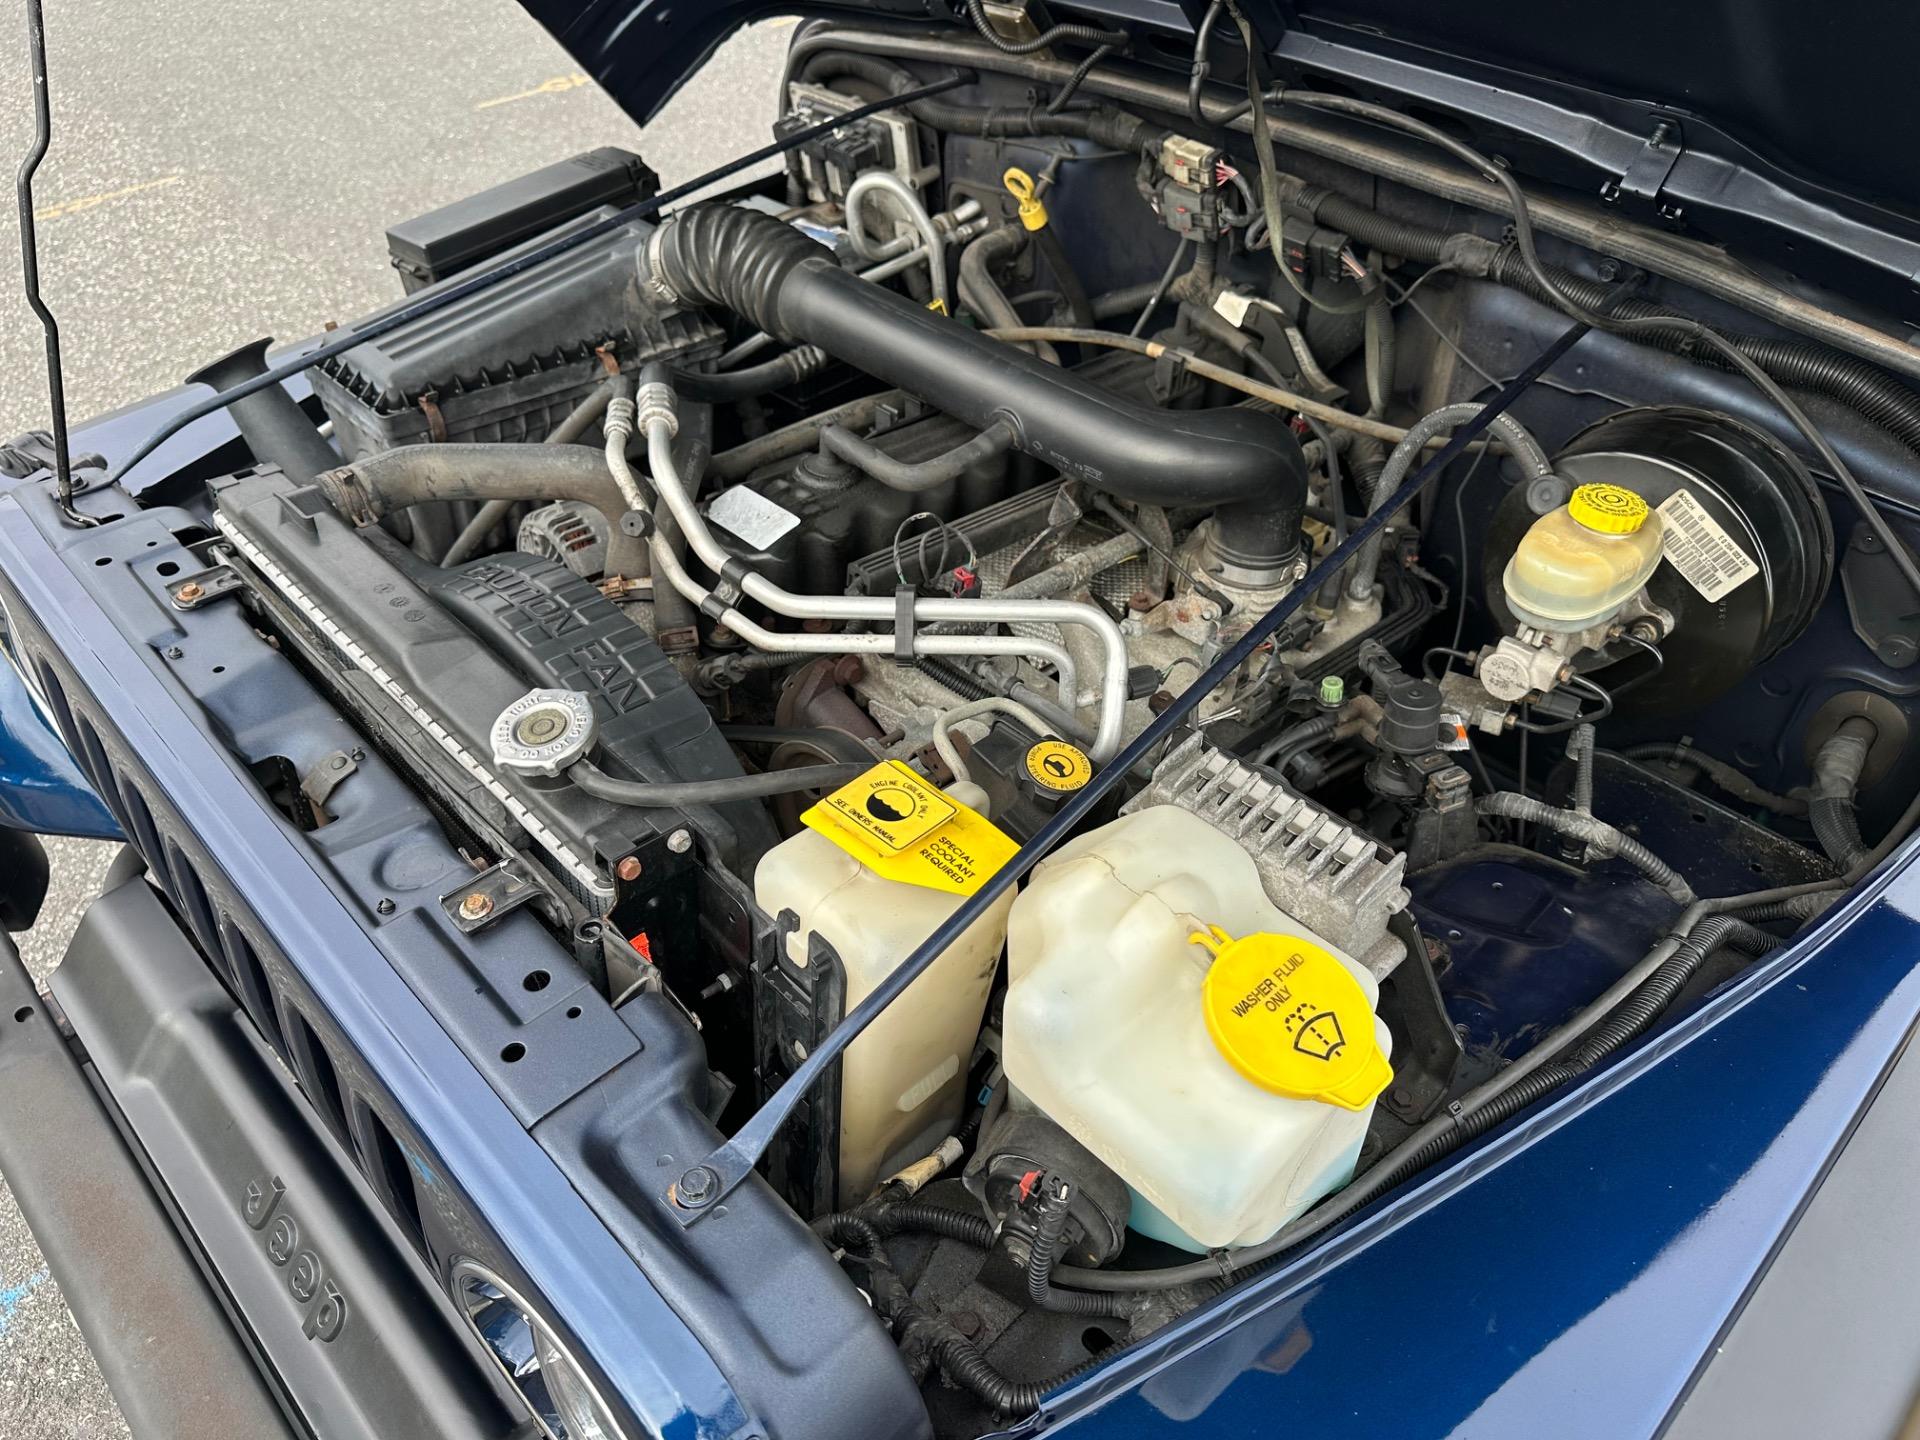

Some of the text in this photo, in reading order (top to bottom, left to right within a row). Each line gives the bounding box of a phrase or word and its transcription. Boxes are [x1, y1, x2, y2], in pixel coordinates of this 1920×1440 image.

[1678, 493, 1696, 511] BOSCH
[464, 565, 585, 637] CAUTION
[571, 641, 651, 714] FAN
[521, 749, 540, 759] DO
[544, 739, 570, 756] NOT
[570, 711, 588, 738] OPEN
[1028, 764, 1057, 788] STEERING
[1060, 780, 1083, 789] FLUID
[869, 779, 929, 820] ENGINE COOLANT ONLY
[833, 798, 897, 844] SEE OWNERS MANUAL
[919, 848, 965, 885] REQUIRED
[929, 843, 976, 879] COOLANT
[938, 835, 975, 867] SPECIAL
[1231, 952, 1305, 1019] WASHER FLUID
[1265, 984, 1293, 1013] ONLY
[241, 1175, 348, 1343] Jeep
